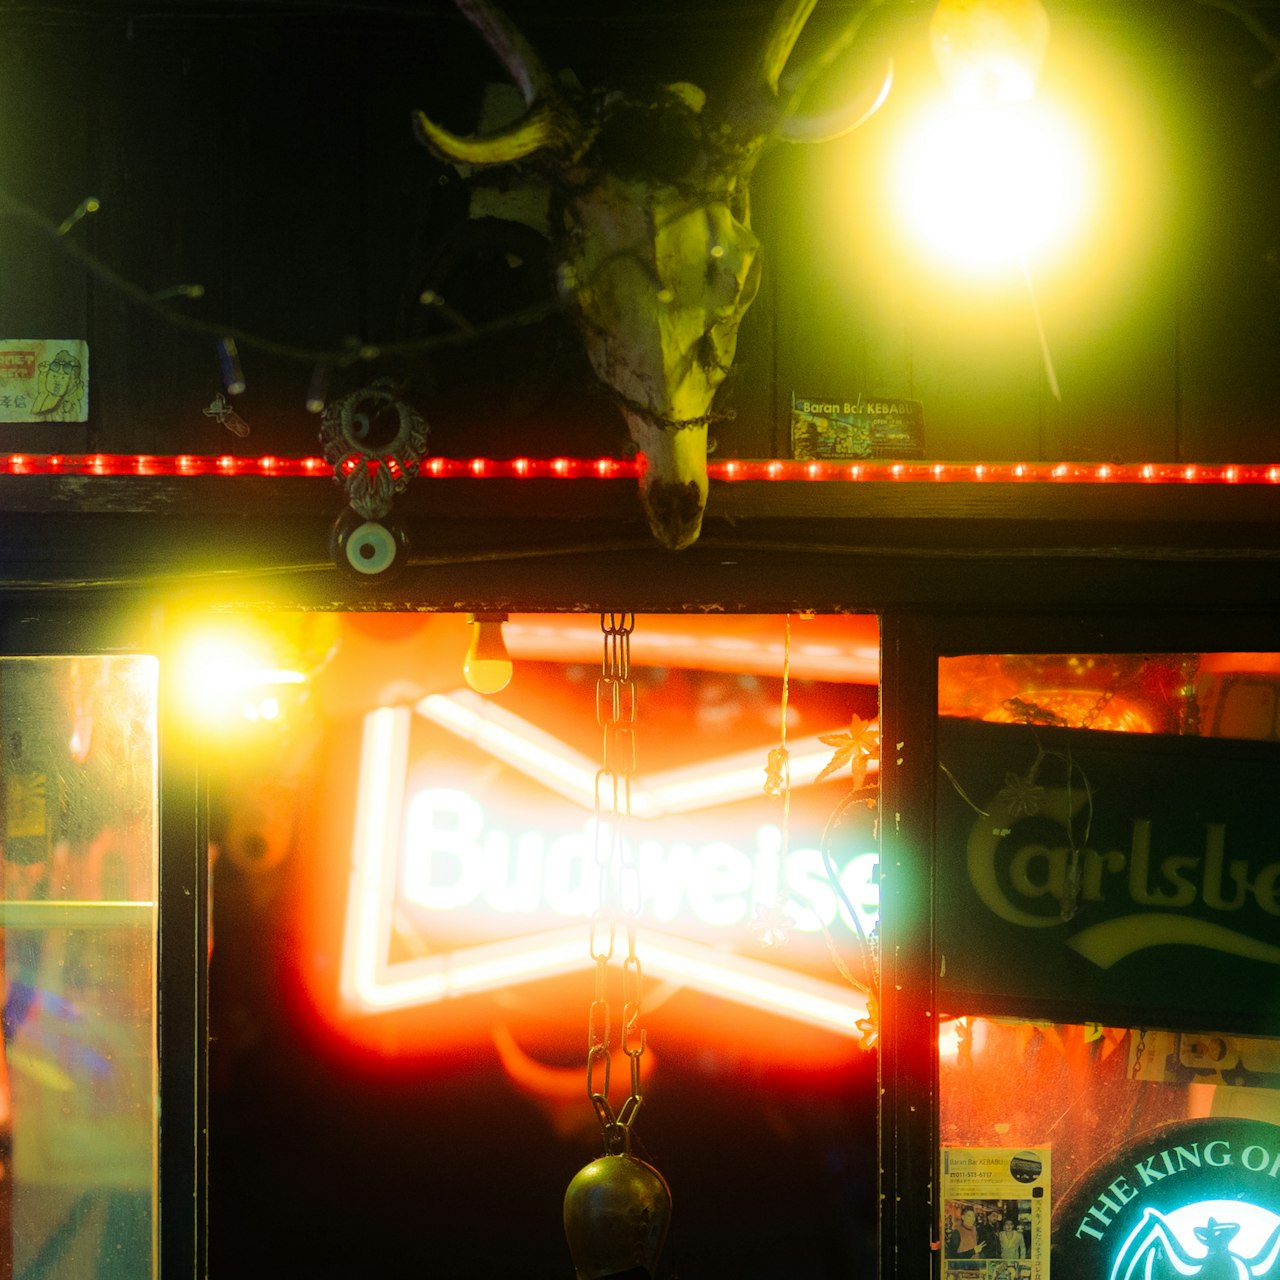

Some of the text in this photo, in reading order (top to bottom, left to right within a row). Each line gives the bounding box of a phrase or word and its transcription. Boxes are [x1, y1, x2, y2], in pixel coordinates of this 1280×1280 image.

[404, 788, 881, 936] Budweise
[1075, 1176, 1140, 1246] THE
[1138, 1139, 1233, 1185] KING
